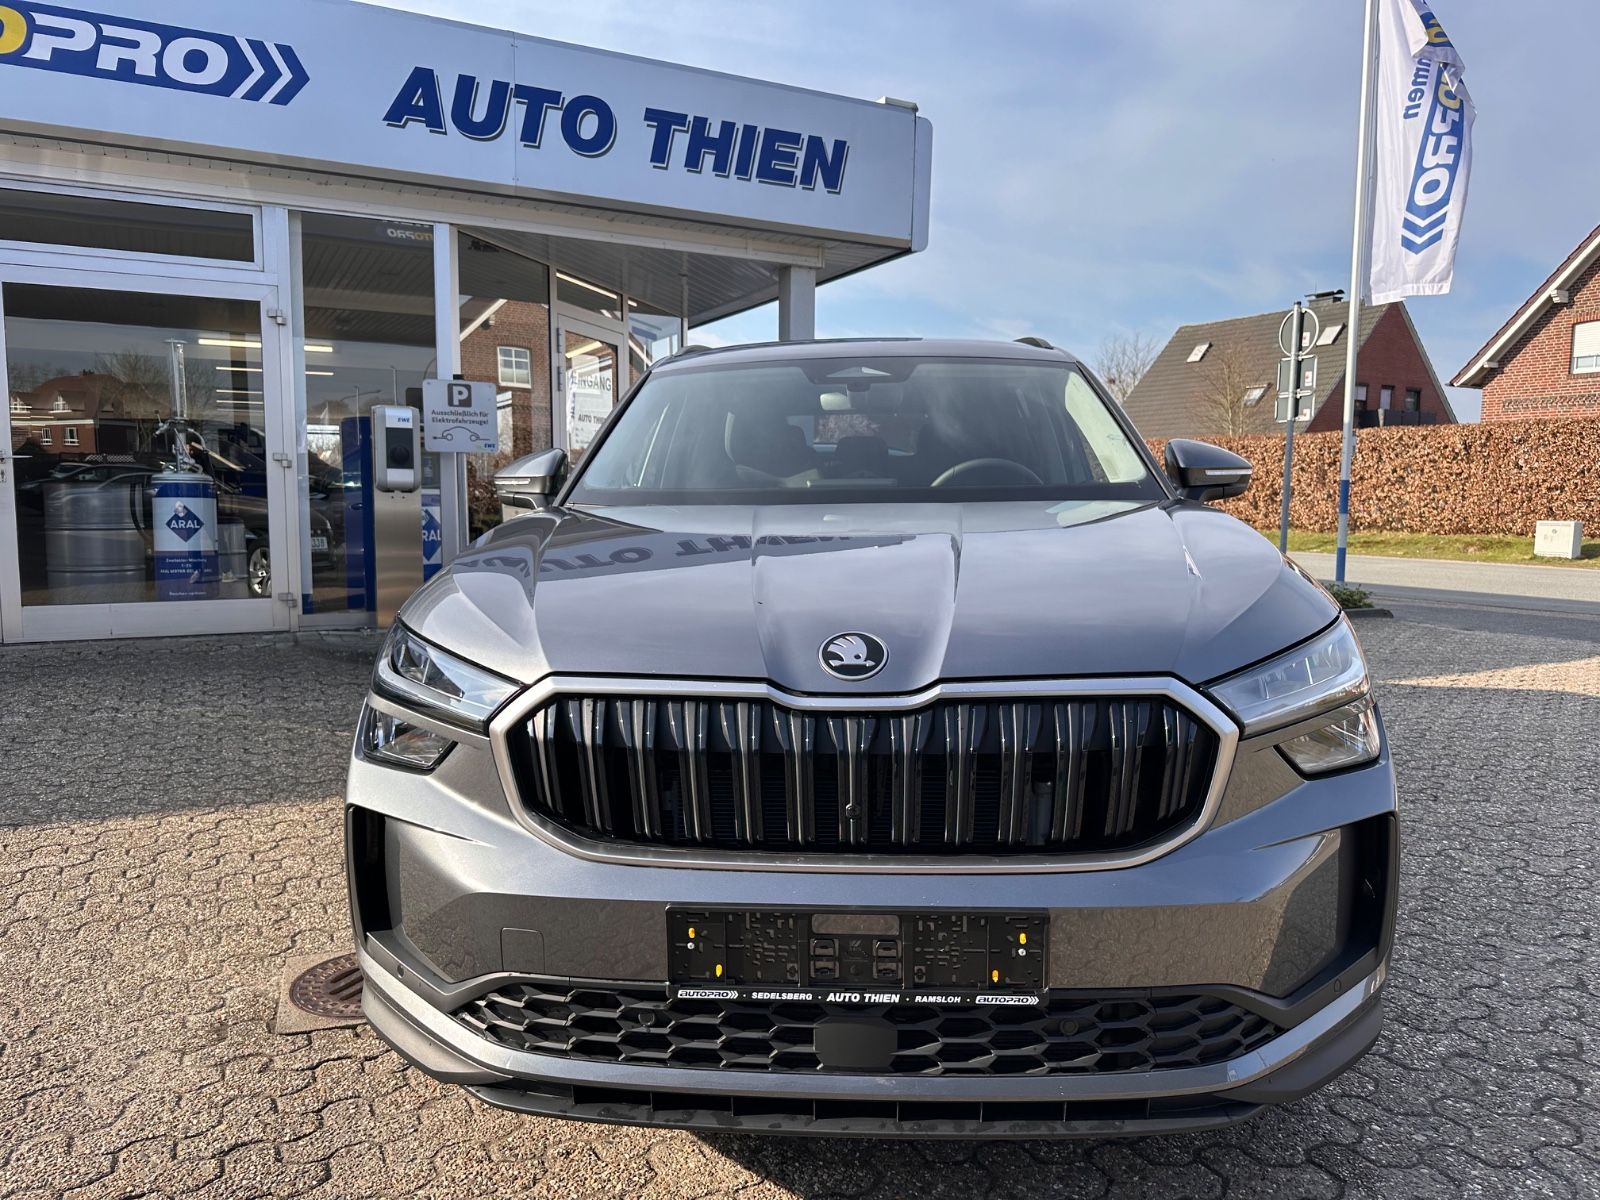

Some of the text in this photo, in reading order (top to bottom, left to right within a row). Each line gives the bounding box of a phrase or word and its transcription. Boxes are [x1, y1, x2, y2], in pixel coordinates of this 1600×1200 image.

[382, 66, 851, 194] AUTO THIEN
[452, 385, 469, 406] P
[431, 409, 478, 417] Ausschließlich
[432, 416, 489, 426] Elektrofahrzeuge!
[578, 414, 592, 424] AUTO
[170, 519, 200, 529] ARAL
[751, 992, 813, 1000] SEDELSBERG
[826, 993, 861, 1003] AUTO
[863, 993, 900, 1004] THIEN
[915, 996, 961, 1004] RAMSLOH
